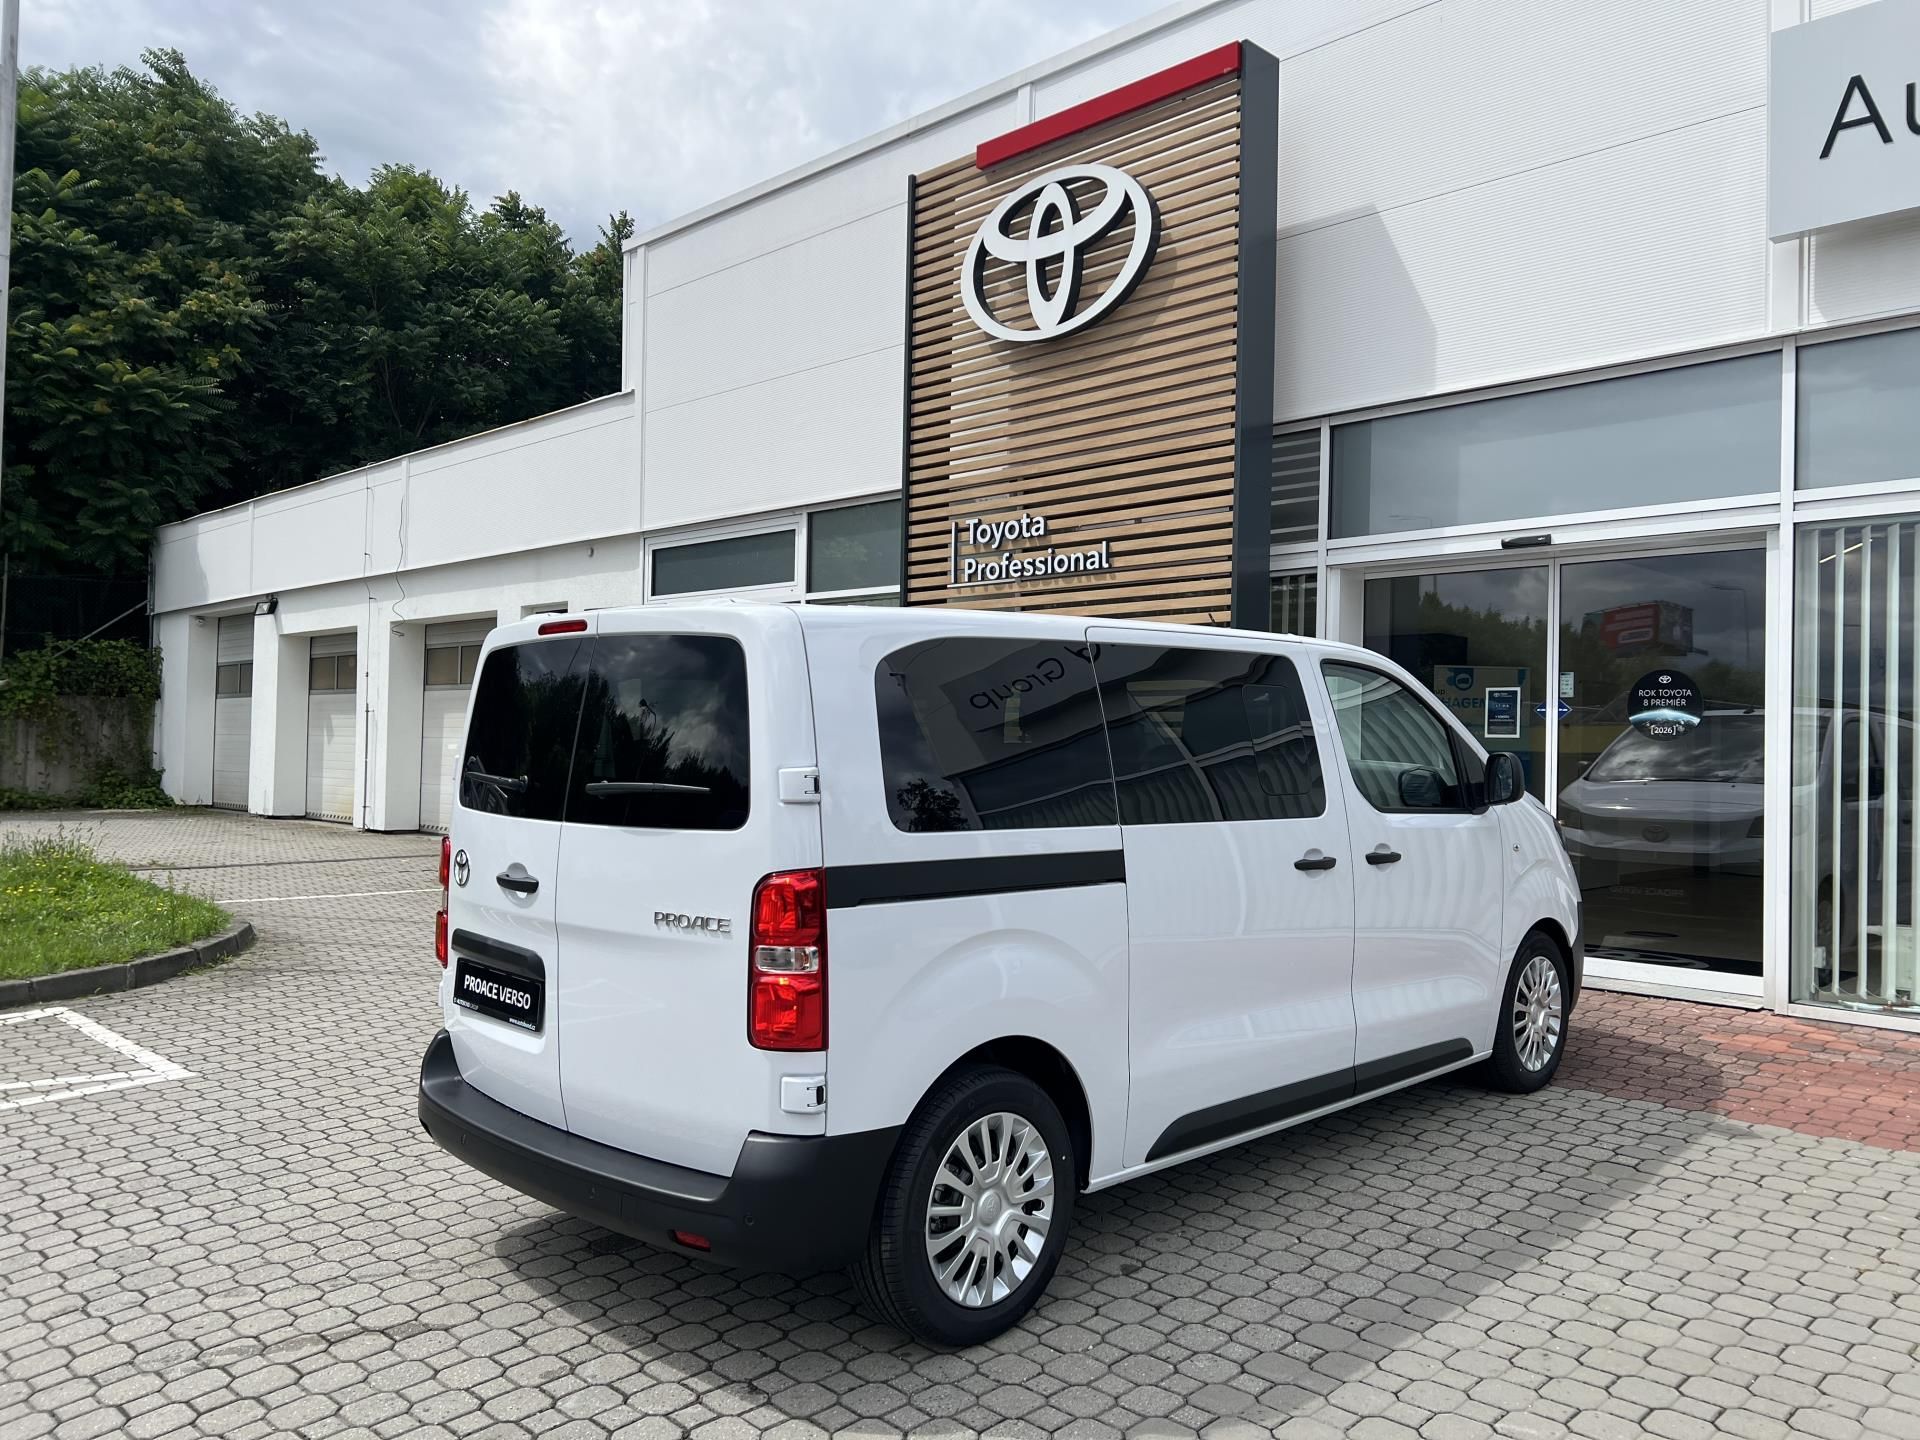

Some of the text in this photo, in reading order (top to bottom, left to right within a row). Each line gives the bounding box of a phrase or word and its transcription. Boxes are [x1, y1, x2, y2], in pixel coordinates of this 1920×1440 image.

[966, 512, 1046, 548] Toyota
[964, 540, 1109, 582] Professional
[1638, 689, 1692, 697] ROK TOYOTA
[654, 911, 731, 933] PROACE
[464, 974, 531, 1010] PROACE VERSO
